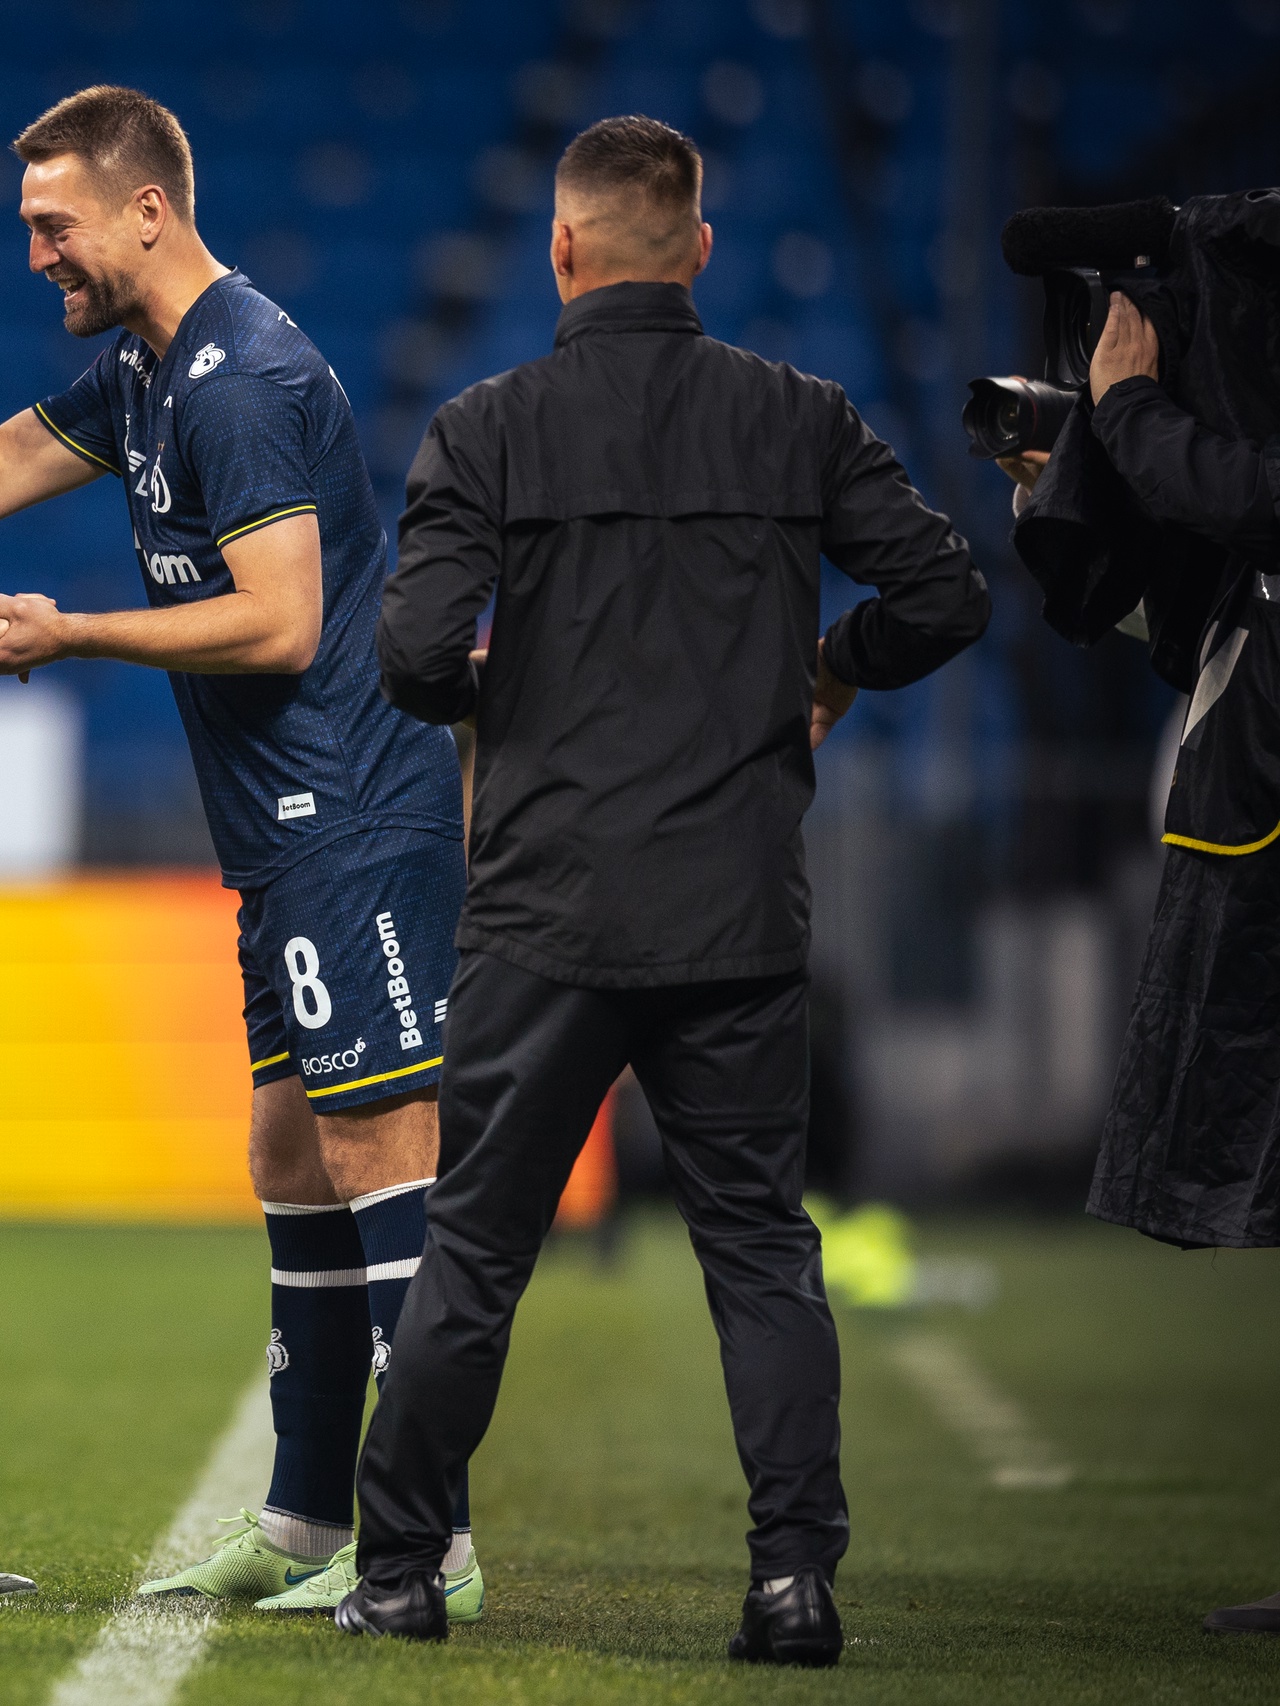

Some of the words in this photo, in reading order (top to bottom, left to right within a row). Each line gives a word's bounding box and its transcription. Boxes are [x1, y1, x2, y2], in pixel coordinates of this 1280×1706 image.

[284, 936, 332, 1030] 8
[377, 911, 424, 1051] BetBoom
[301, 1049, 360, 1076] BOSCO
